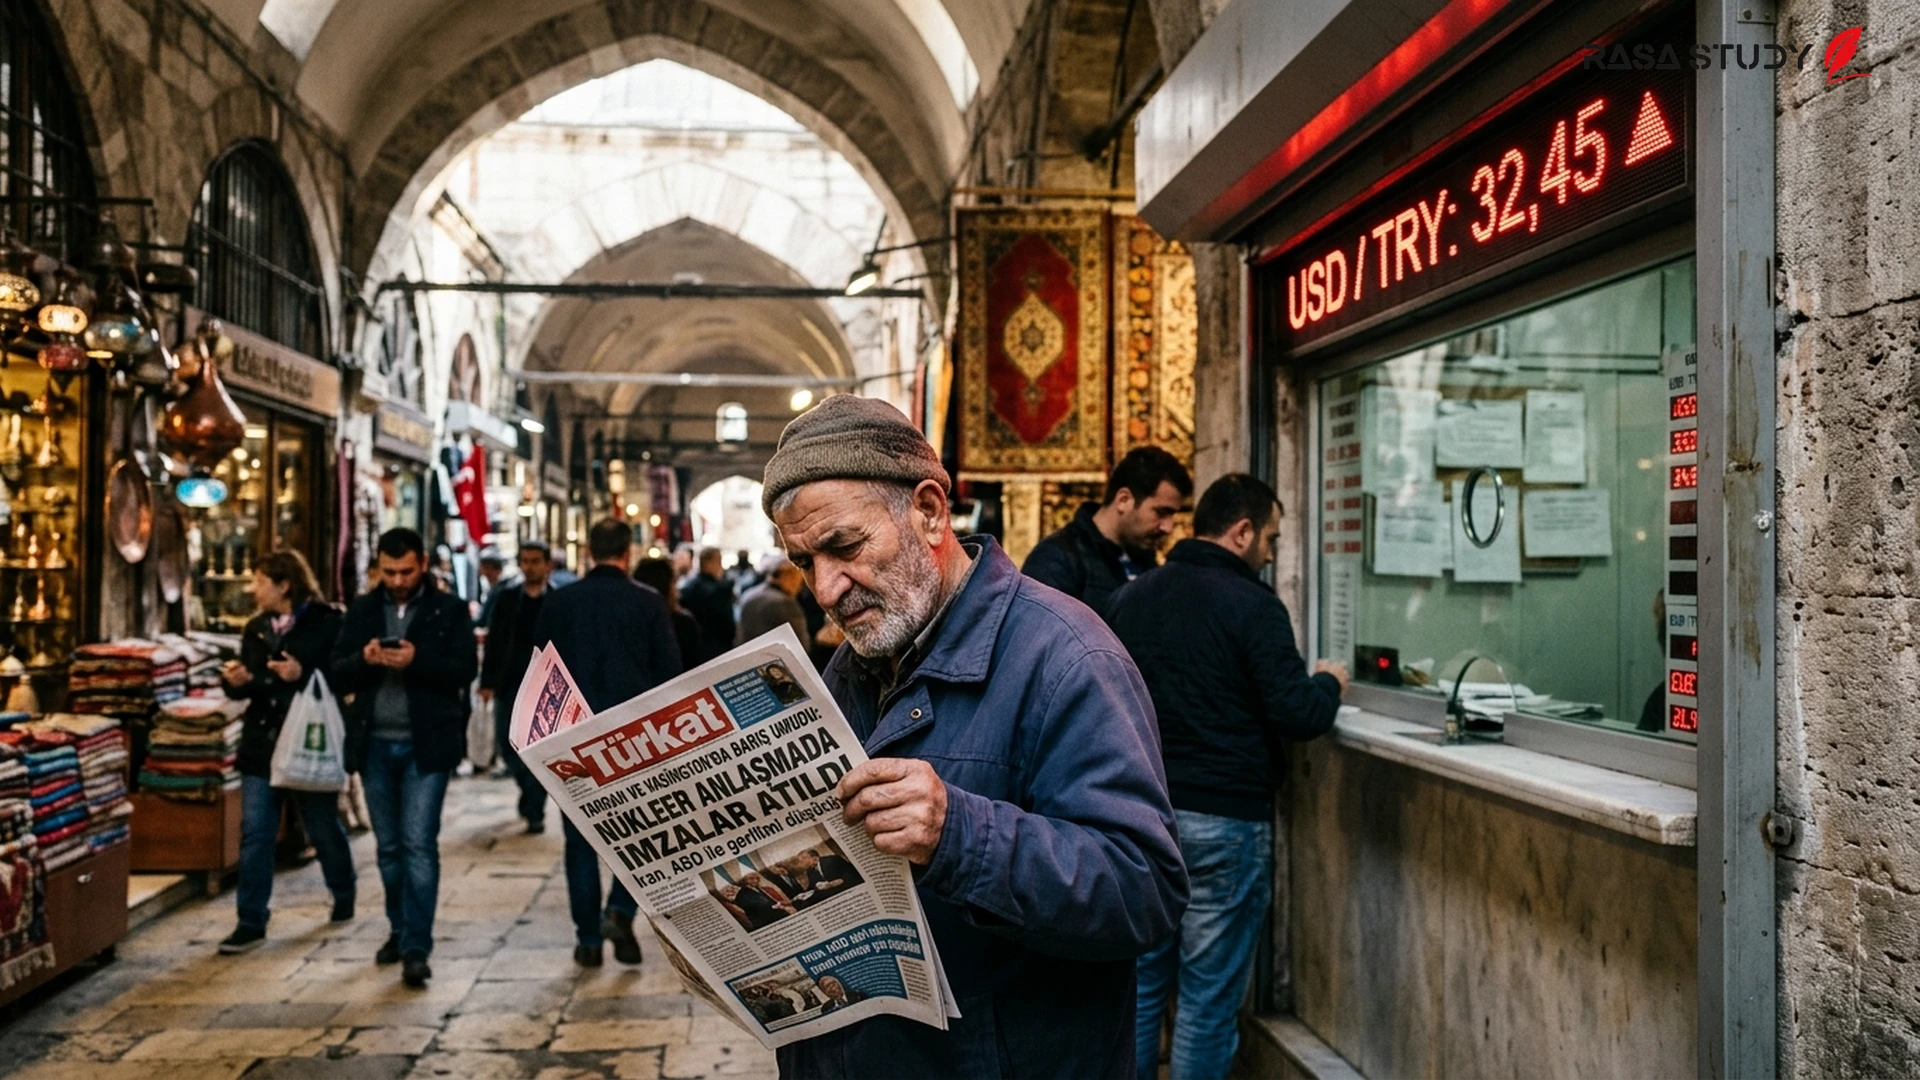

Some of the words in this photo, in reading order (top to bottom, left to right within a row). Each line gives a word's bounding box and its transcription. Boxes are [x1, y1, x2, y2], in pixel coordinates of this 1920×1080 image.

[1471, 99, 1606, 243] 32,45
[579, 696, 726, 778] Türkat
[593, 790, 696, 846] NÜKLEER
[695, 726, 840, 808] ANLAŞMADA
[626, 782, 646, 801] VE
[730, 729, 770, 758] BARIŞ
[613, 801, 756, 872] İMZALAR
[756, 753, 854, 818] ATILDI
